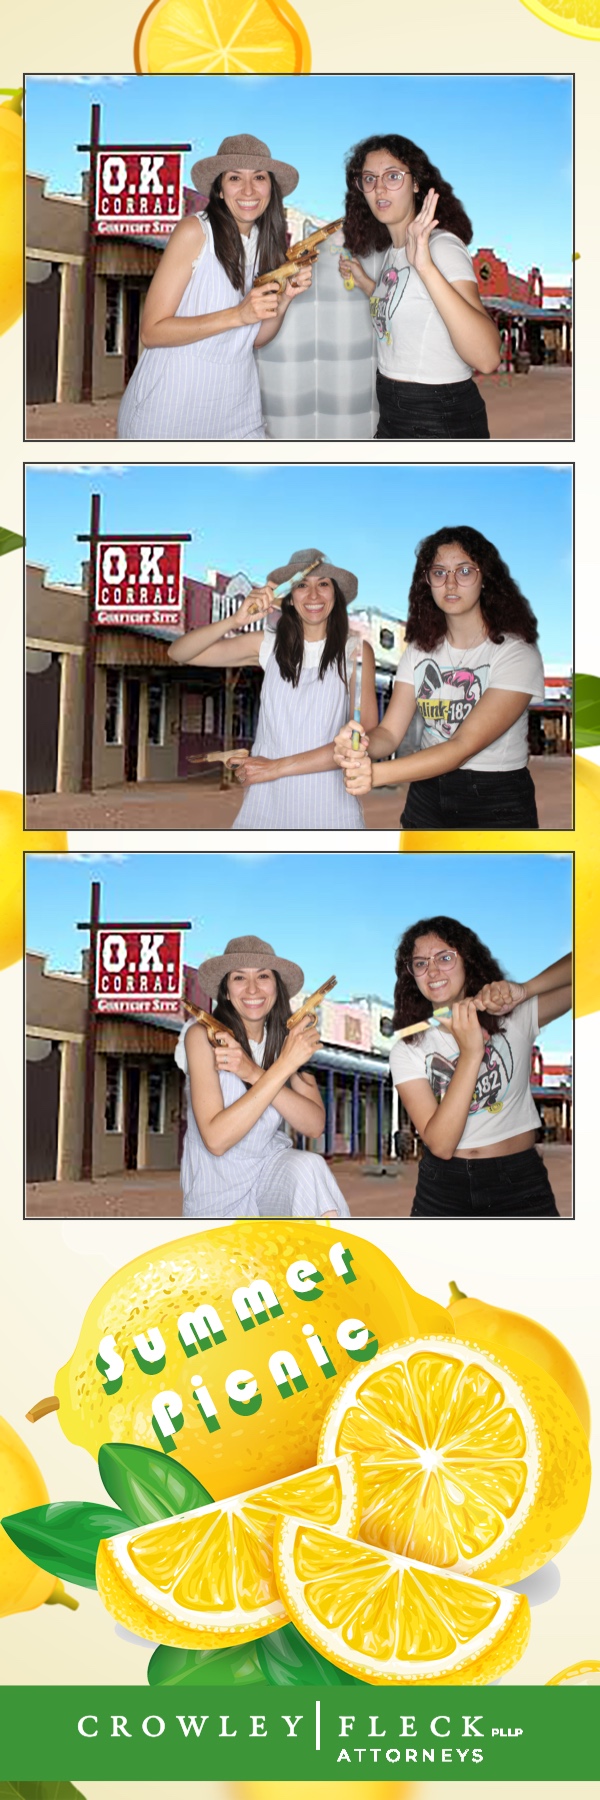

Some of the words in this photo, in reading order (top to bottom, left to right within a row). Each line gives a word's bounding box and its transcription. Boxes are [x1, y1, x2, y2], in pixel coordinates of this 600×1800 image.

[102, 157, 175, 195] O.K.
[101, 198, 177, 214] CORRAL
[102, 547, 175, 585] O.K.
[101, 588, 177, 604] CORRAL
[102, 935, 175, 973] O.K.
[101, 976, 177, 992] CORRAL
